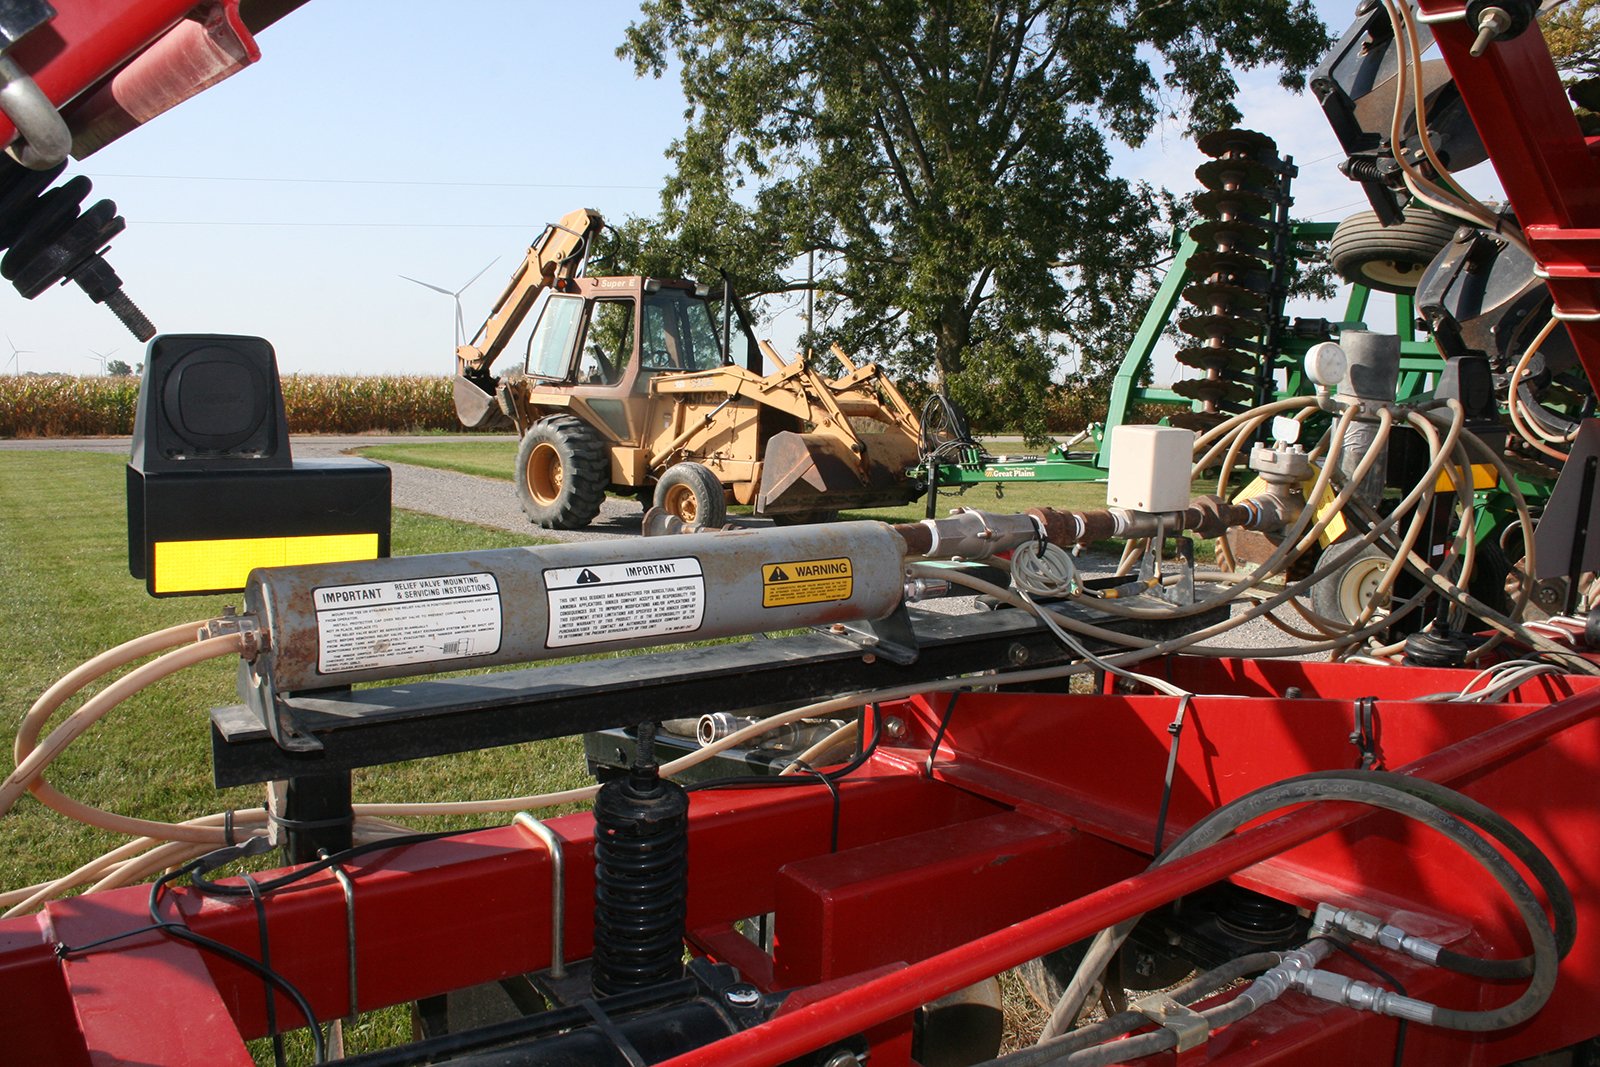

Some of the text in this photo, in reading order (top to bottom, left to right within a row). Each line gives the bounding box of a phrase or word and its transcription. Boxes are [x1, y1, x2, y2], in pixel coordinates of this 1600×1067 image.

[601, 278, 636, 288] Super E
[993, 469, 1036, 478] Great Plains
[625, 563, 676, 577] IMPORTANT
[795, 562, 848, 577] WARNING
[394, 576, 479, 590] RELIEF VALVE MOUNTING
[322, 588, 382, 604] IMPORTANT
[396, 583, 492, 600] & SERVICING INSTRUCTIONS
